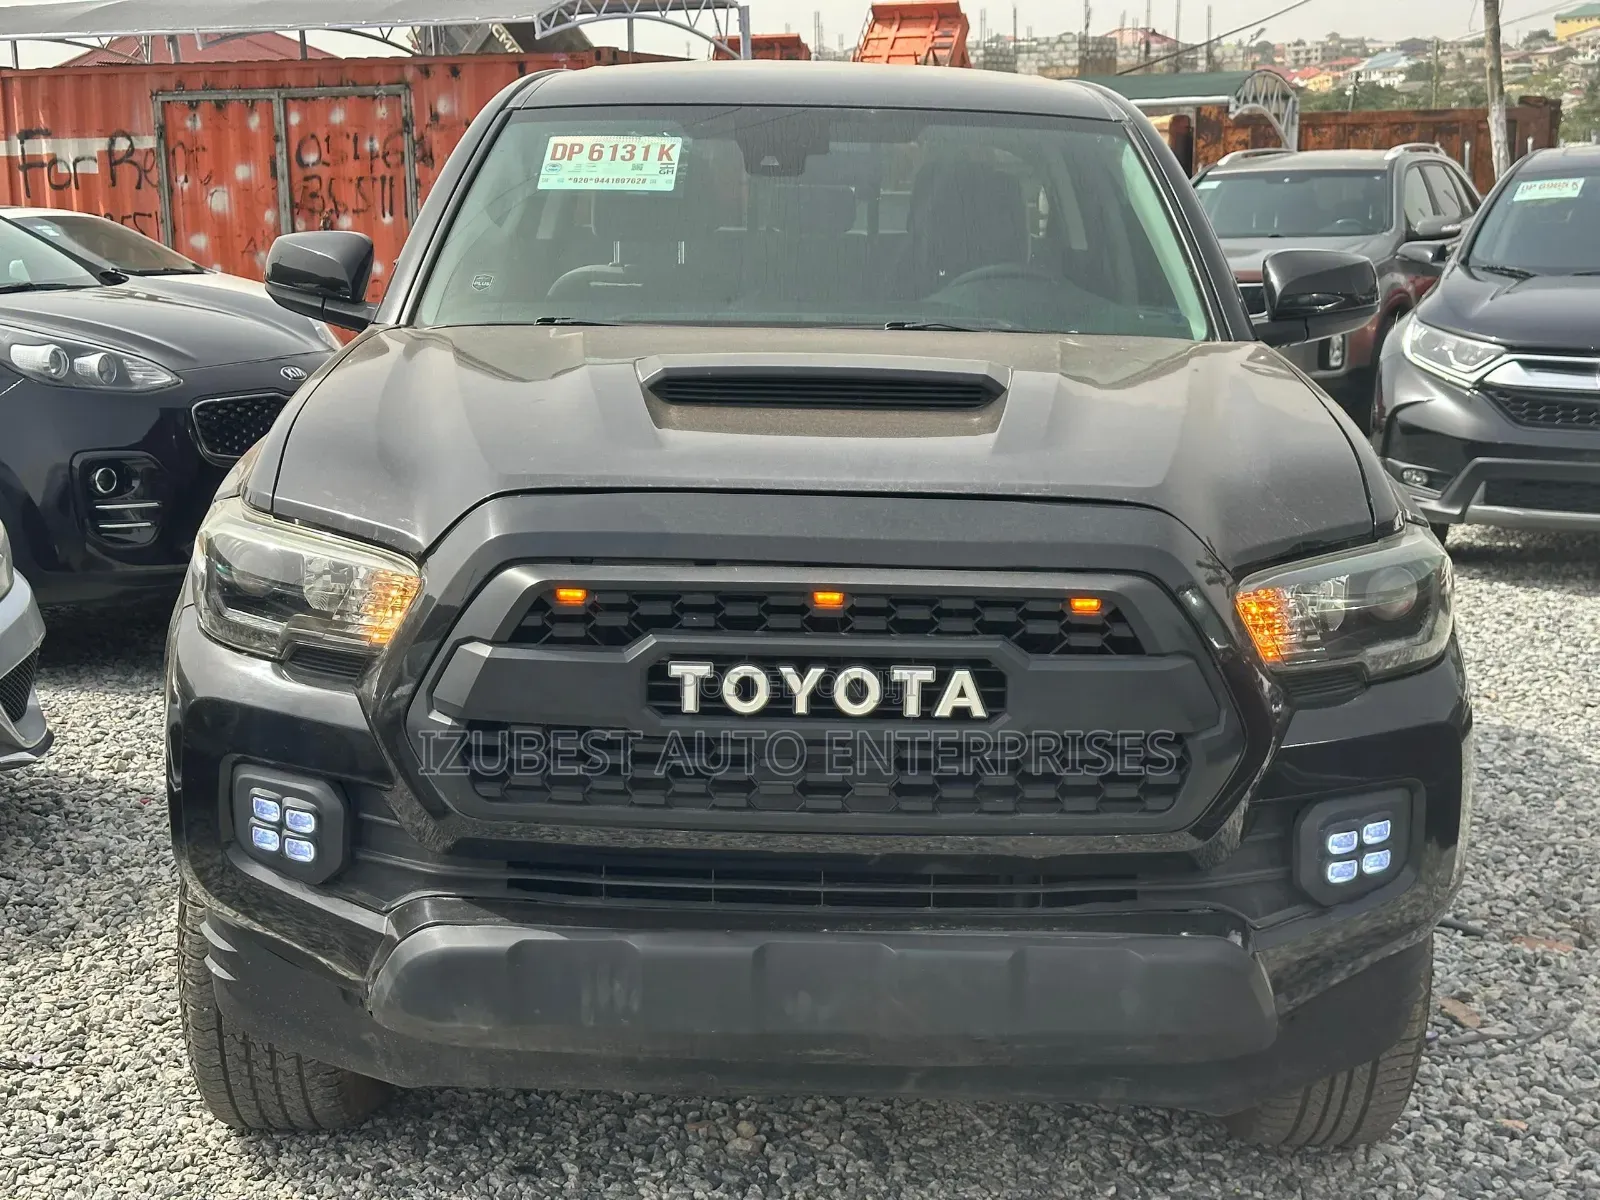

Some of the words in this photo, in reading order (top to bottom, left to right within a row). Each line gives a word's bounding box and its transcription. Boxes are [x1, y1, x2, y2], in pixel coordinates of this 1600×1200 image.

[18, 127, 98, 199] For
[550, 143, 584, 161] DP
[587, 143, 651, 161] 6131
[657, 144, 676, 161] K
[668, 661, 988, 718] TOYOTA
